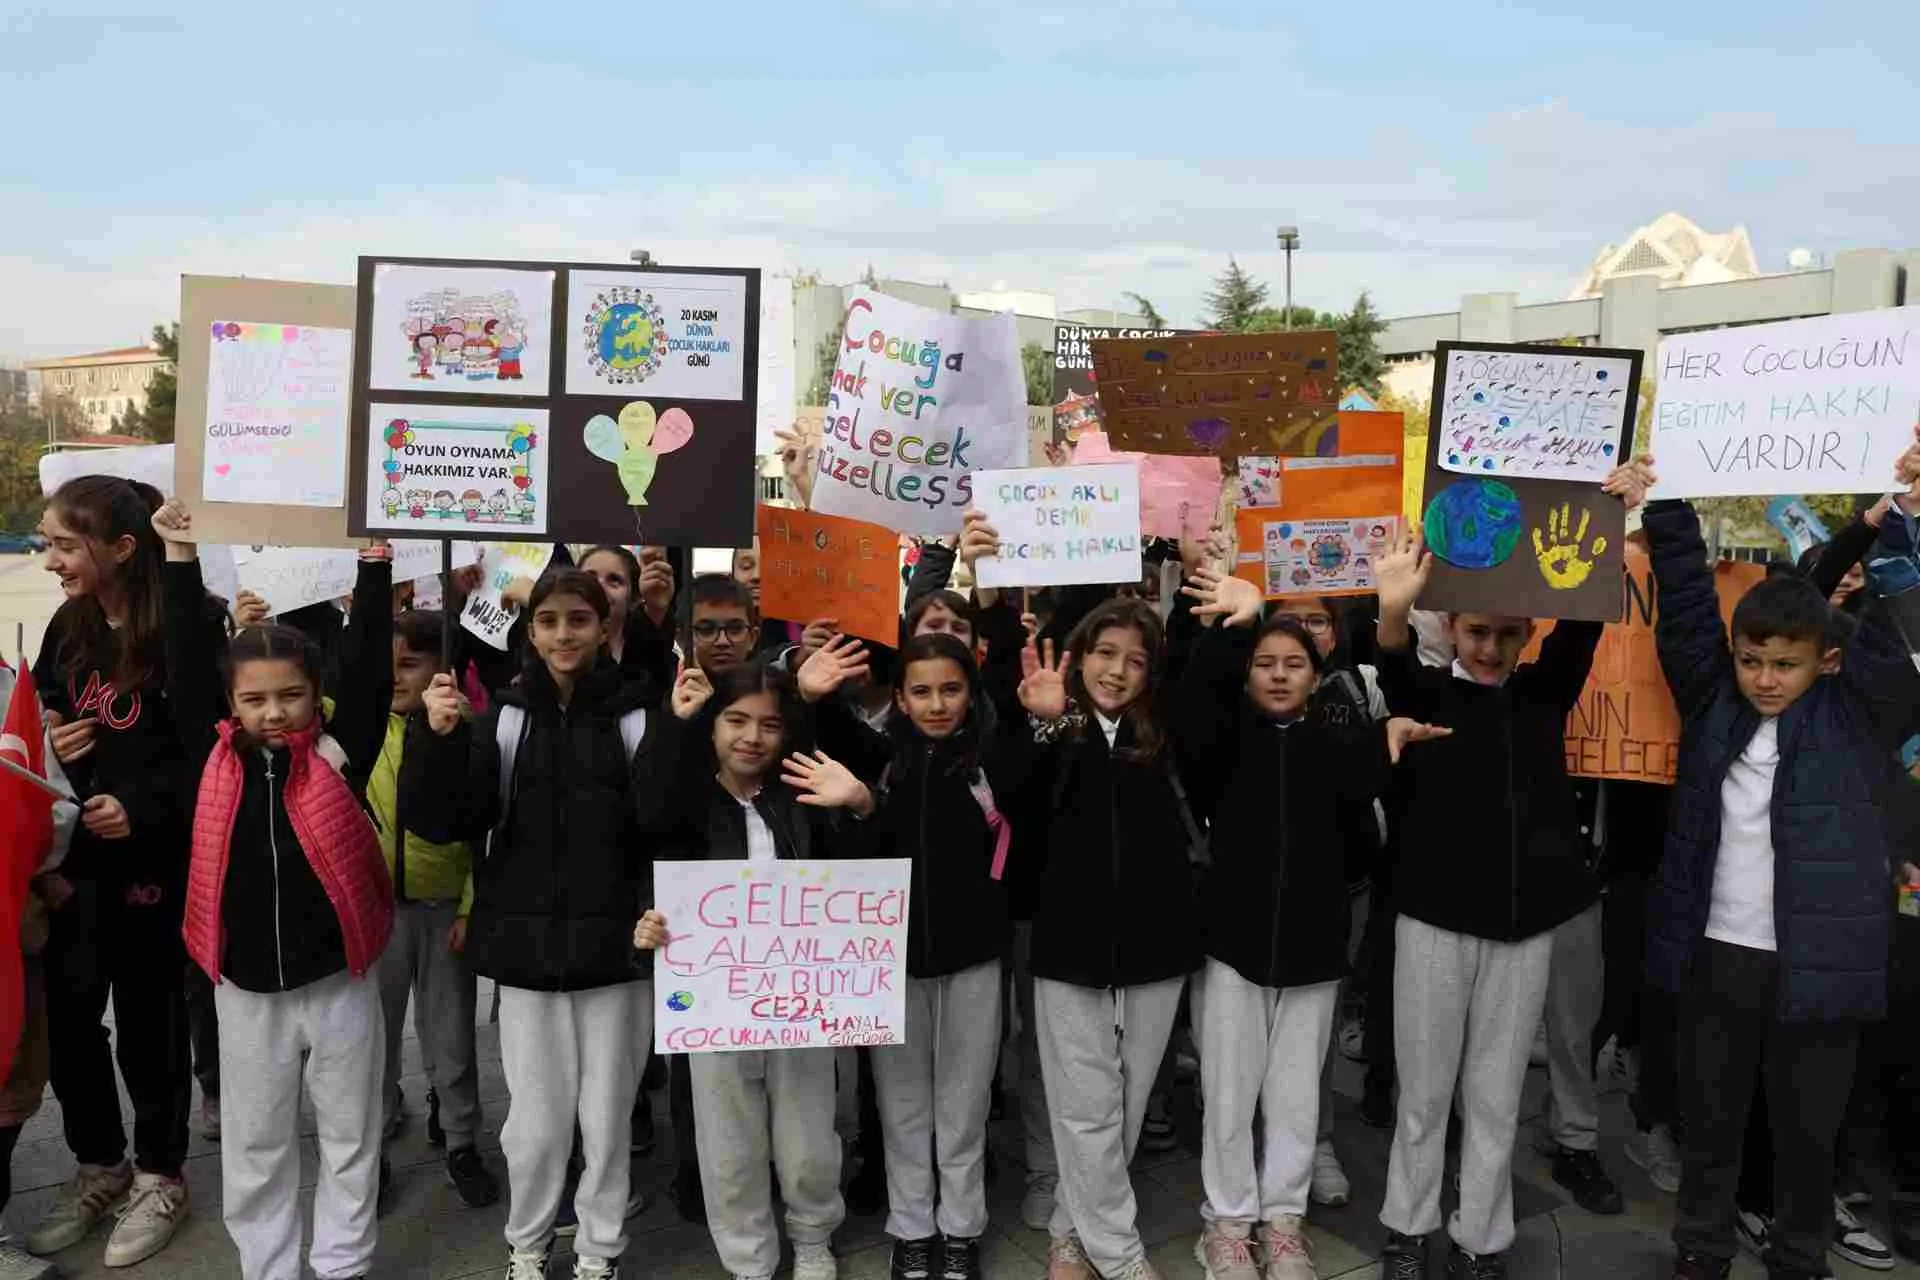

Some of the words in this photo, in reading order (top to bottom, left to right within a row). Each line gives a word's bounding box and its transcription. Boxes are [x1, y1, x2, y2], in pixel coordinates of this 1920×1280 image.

[680, 309, 691, 321] 20
[692, 309, 718, 322] KASIM
[686, 323, 713, 337] DÜNYA
[667, 339, 695, 353] ÇOCUK
[695, 340, 730, 353] HAKLARI
[845, 298, 964, 388] Çocuğa
[1058, 341, 1091, 356] HAK
[687, 353, 710, 367] GÜNÜ
[1664, 348, 1721, 380] HER
[1743, 330, 1909, 376] ÇOCUĞUN
[881, 382, 937, 420] ver
[1770, 383, 1890, 421] HAKKI
[404, 444, 446, 457] OYUN
[450, 446, 516, 460] OYNAMA
[1698, 431, 1847, 473] VARDIR
[404, 463, 475, 477] HAKKIMIZ
[478, 466, 512, 479] VAR.
[728, 967, 777, 995] EN
[666, 1026, 812, 1050] ÇOCUKLARIN
[820, 1014, 889, 1034] HAYAL
